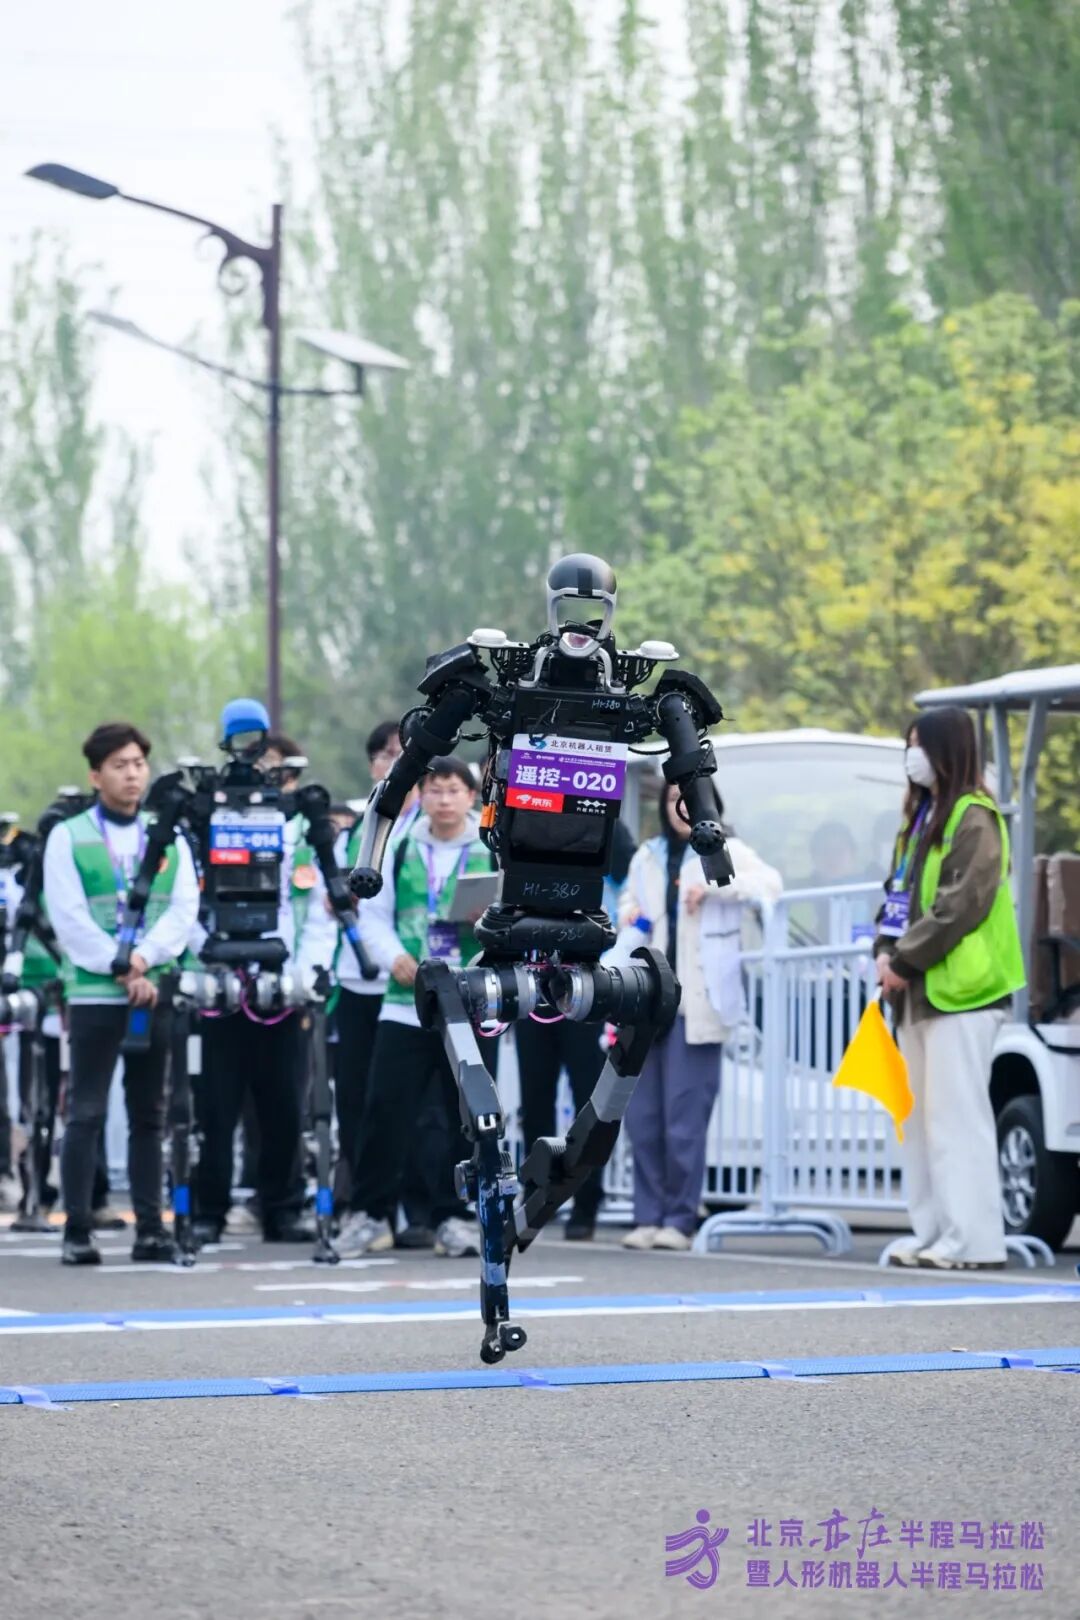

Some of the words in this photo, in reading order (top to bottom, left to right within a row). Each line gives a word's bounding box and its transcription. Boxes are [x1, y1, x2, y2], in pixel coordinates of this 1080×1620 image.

[550, 739, 613, 753] 北京机器人租赁
[515, 764, 617, 793] 遥控-020
